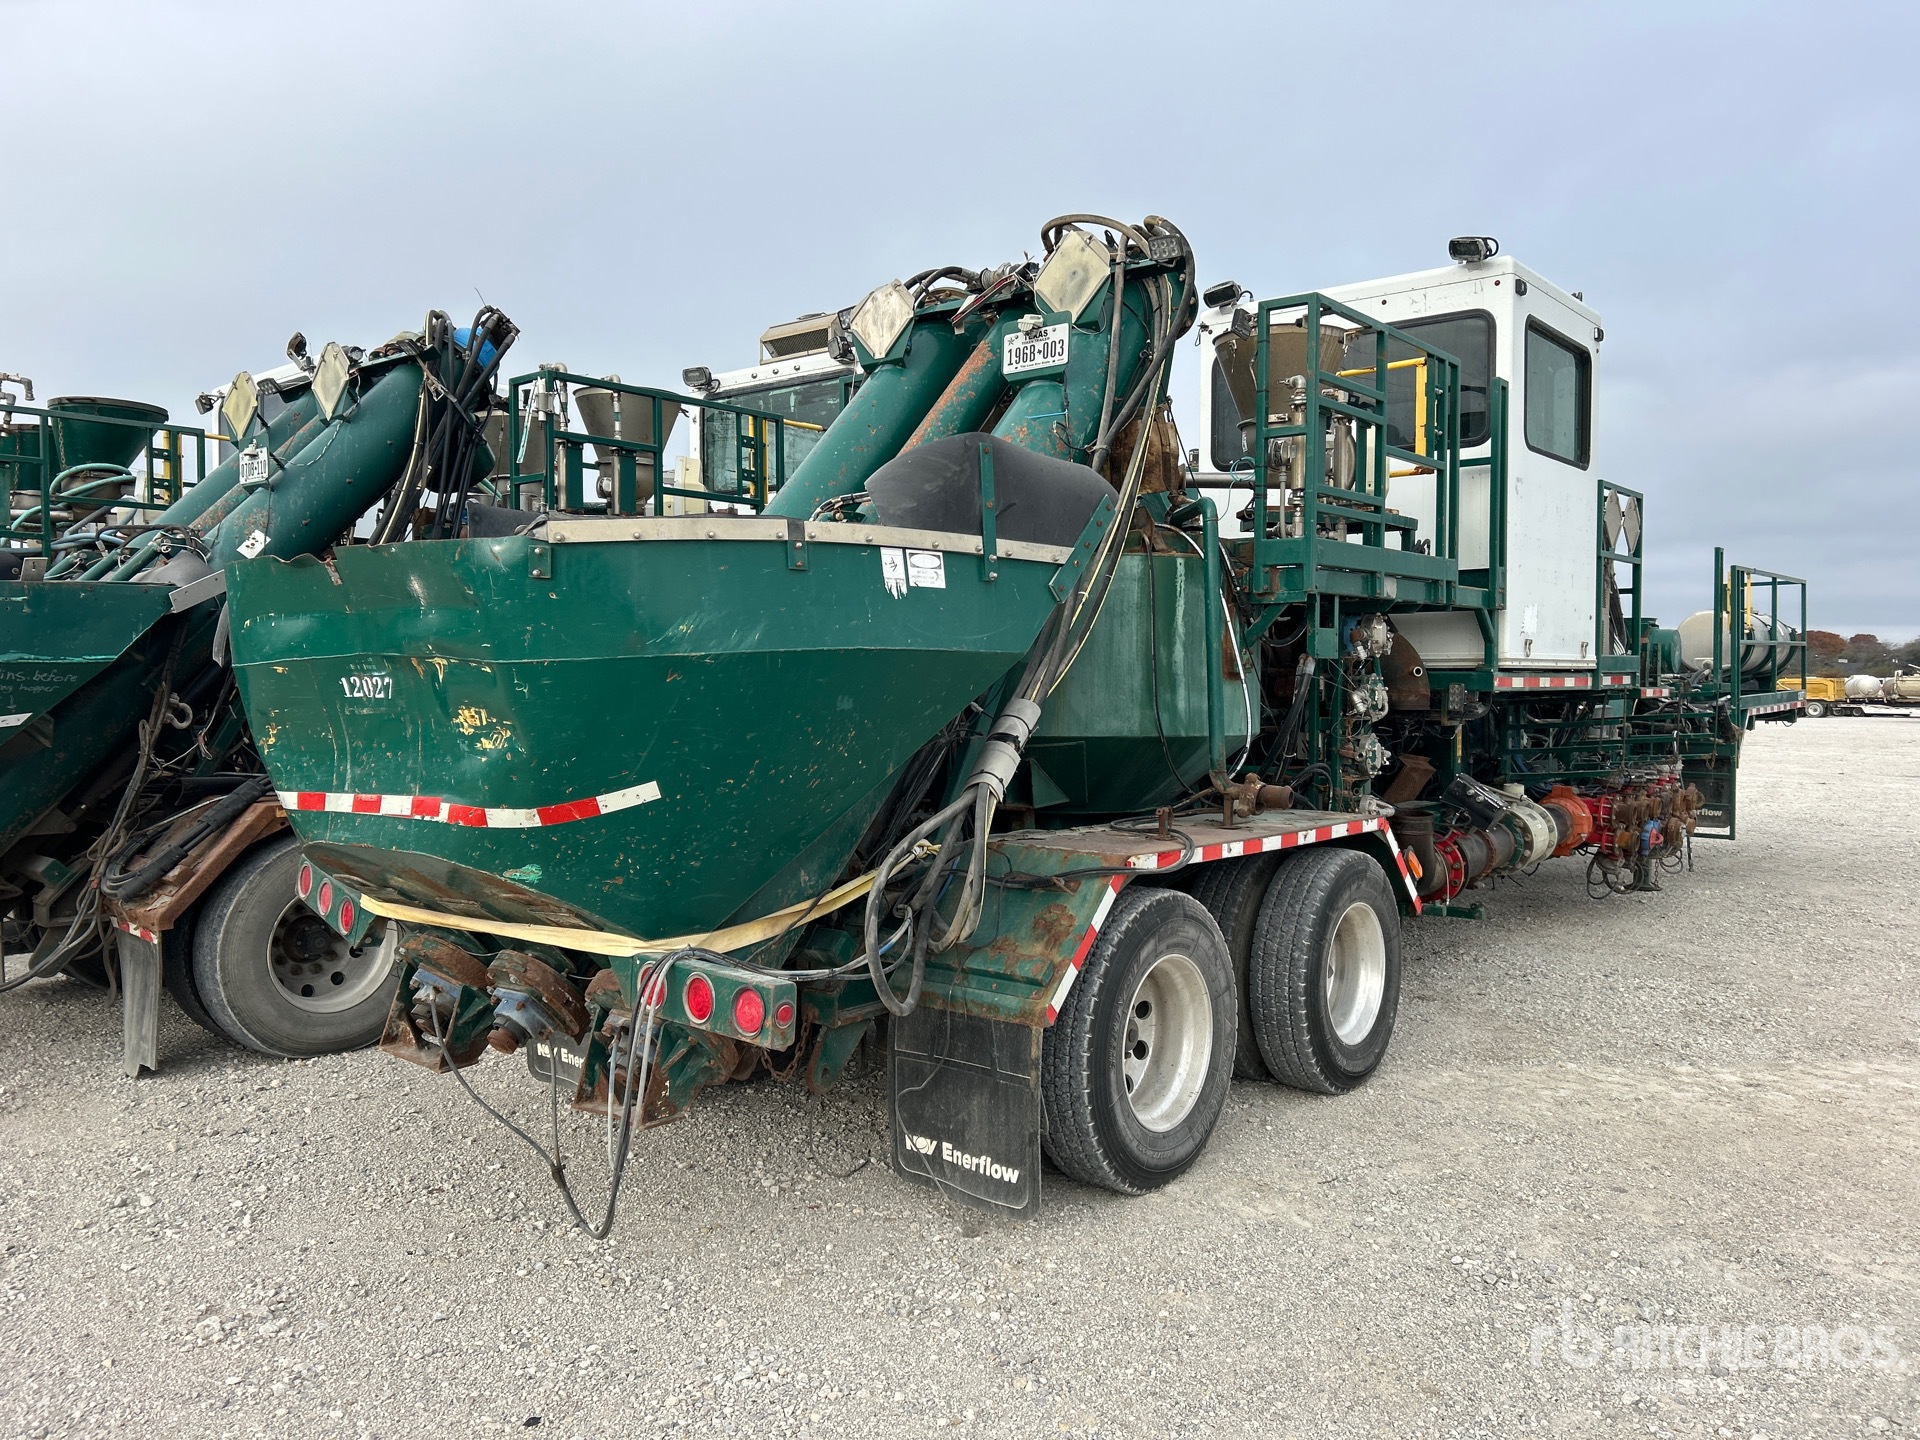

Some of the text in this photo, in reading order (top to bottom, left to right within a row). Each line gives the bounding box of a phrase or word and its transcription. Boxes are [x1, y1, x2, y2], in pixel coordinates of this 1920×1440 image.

[1007, 339, 1065, 366] 196B 003
[338, 676, 393, 700] 12027
[941, 1141, 1020, 1184] Enerflow
